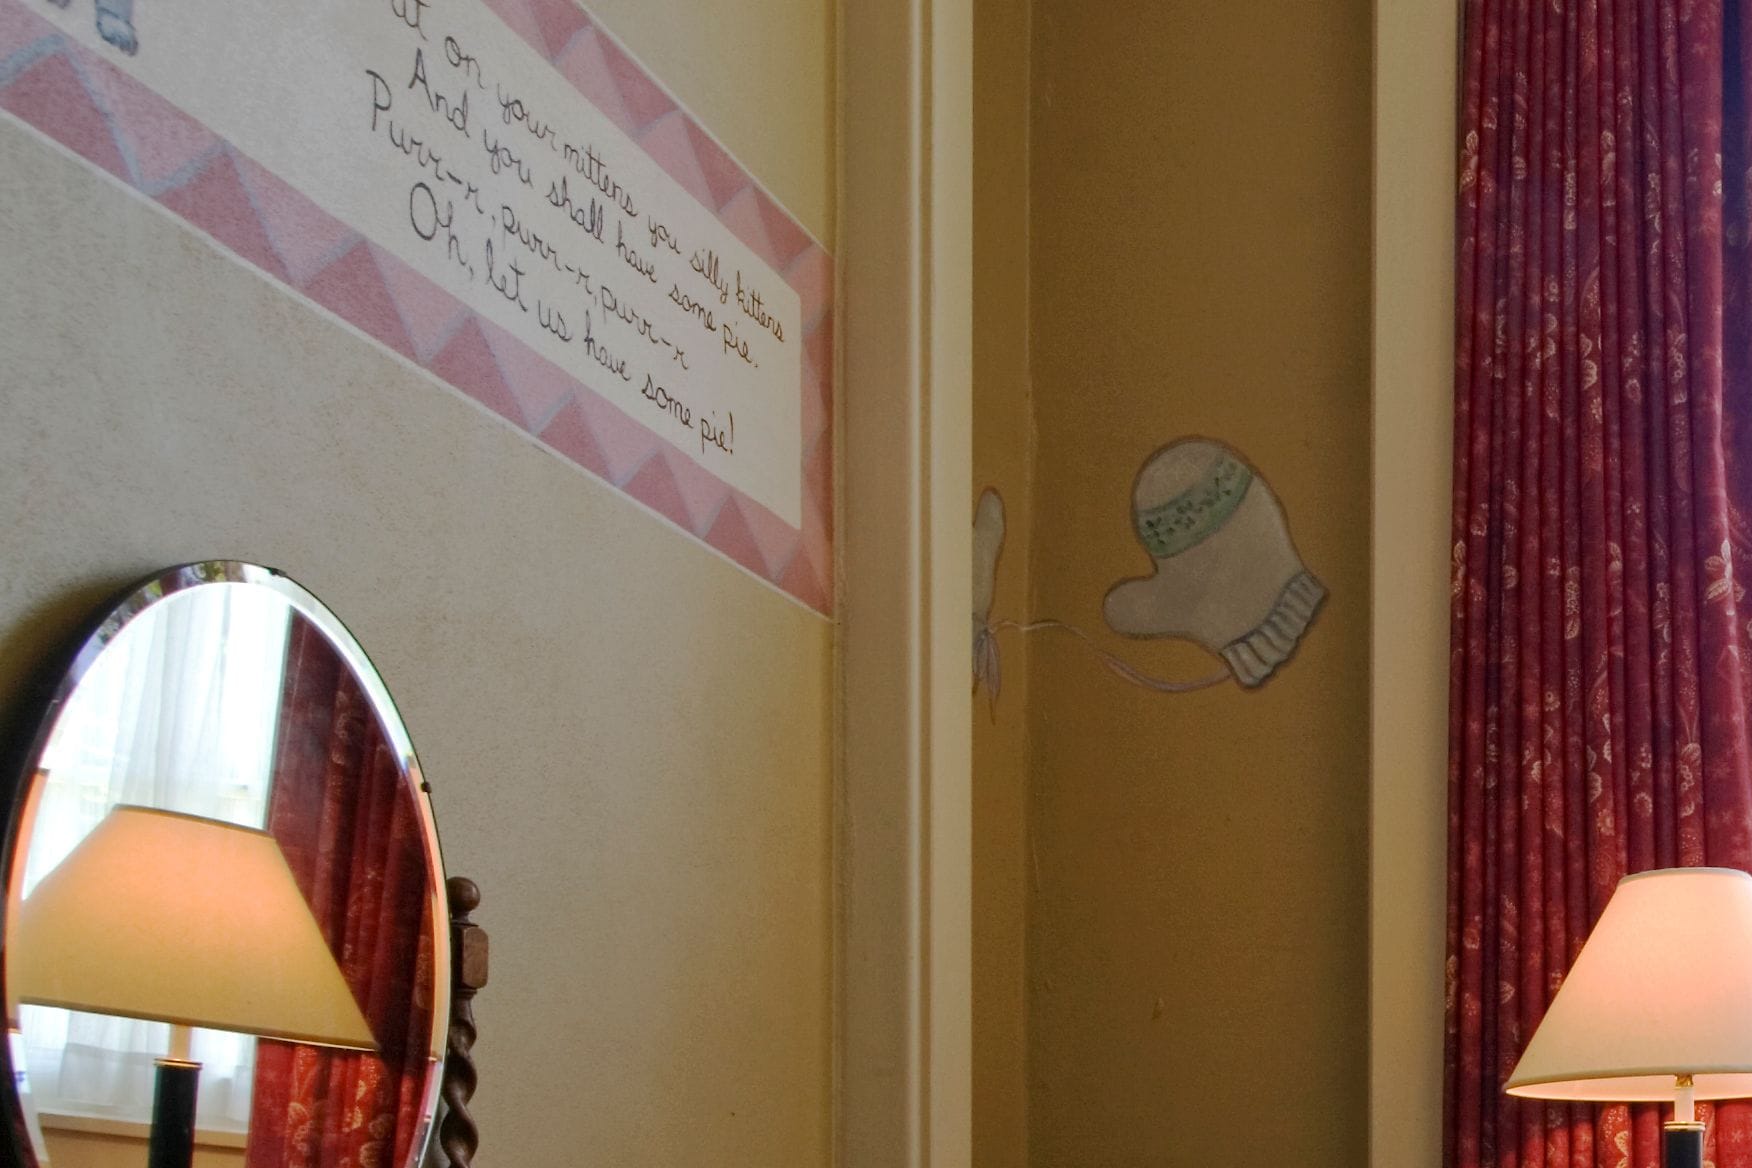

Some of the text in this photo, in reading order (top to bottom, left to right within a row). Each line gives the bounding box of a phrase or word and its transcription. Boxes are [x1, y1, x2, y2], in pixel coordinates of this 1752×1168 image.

[408, 47, 759, 368] And you shall have some pie.
[410, 182, 734, 455] Oh, let us have some pie!
[497, 83, 557, 151] your
[563, 143, 638, 217] mittens
[648, 216, 681, 254] you
[689, 249, 729, 304] silly
[735, 270, 784, 342] kittens
